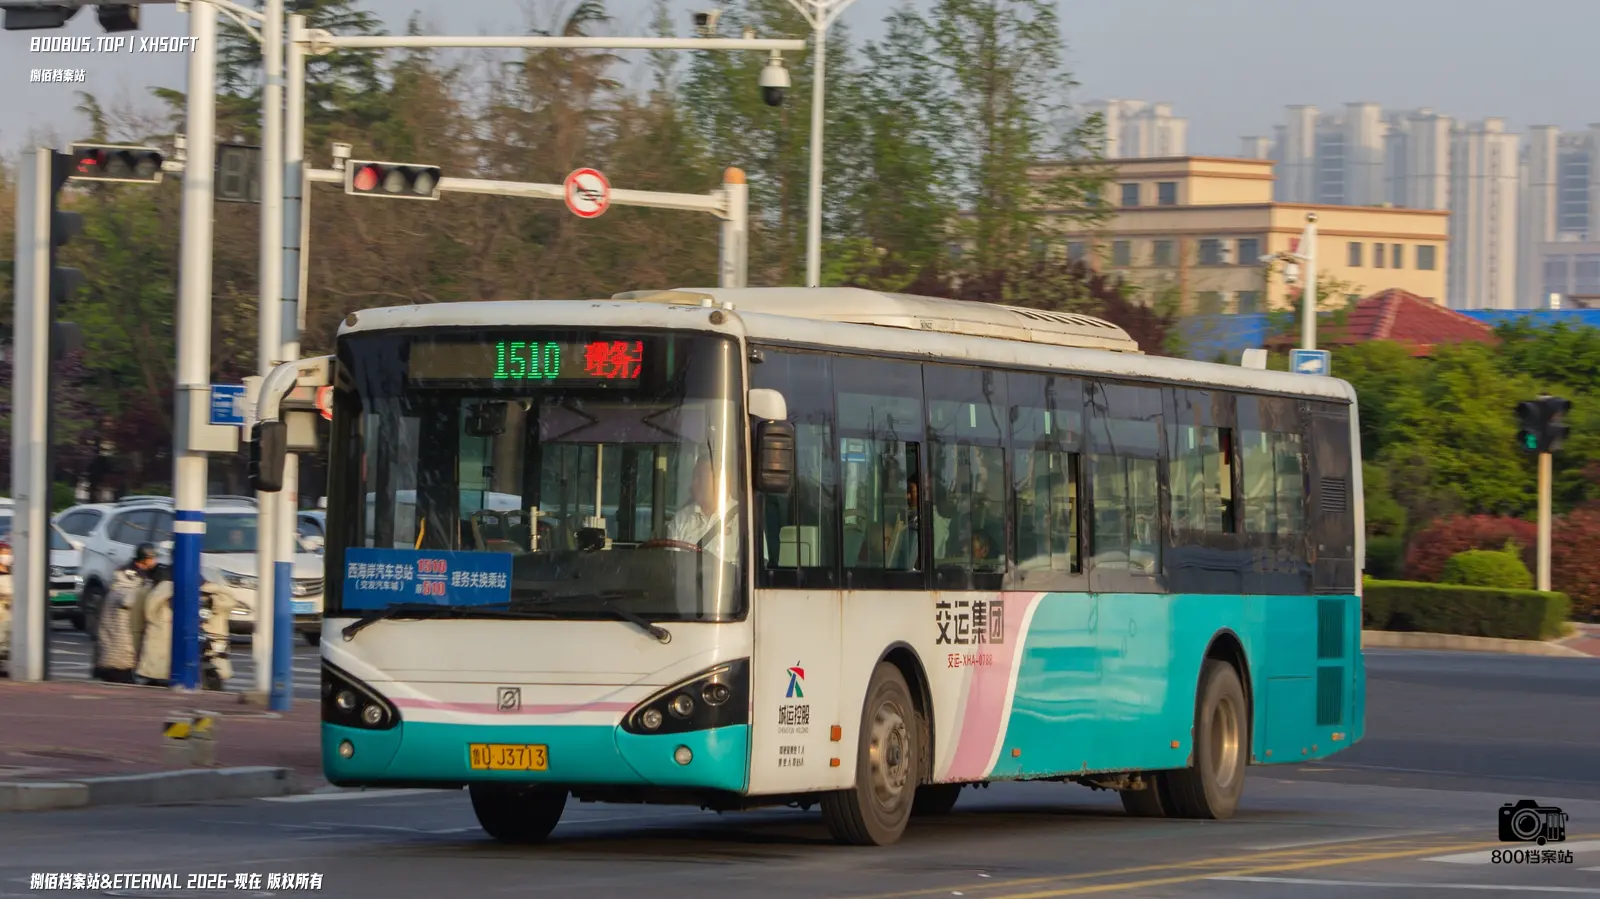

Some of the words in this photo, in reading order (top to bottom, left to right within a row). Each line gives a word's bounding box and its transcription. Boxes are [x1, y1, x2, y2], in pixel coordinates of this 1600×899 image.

[493, 341, 561, 379] 1510
[347, 562, 414, 581] 西海岸汽车总站
[451, 571, 507, 589] 理务关换乘站
[935, 600, 1005, 645] 交运集团
